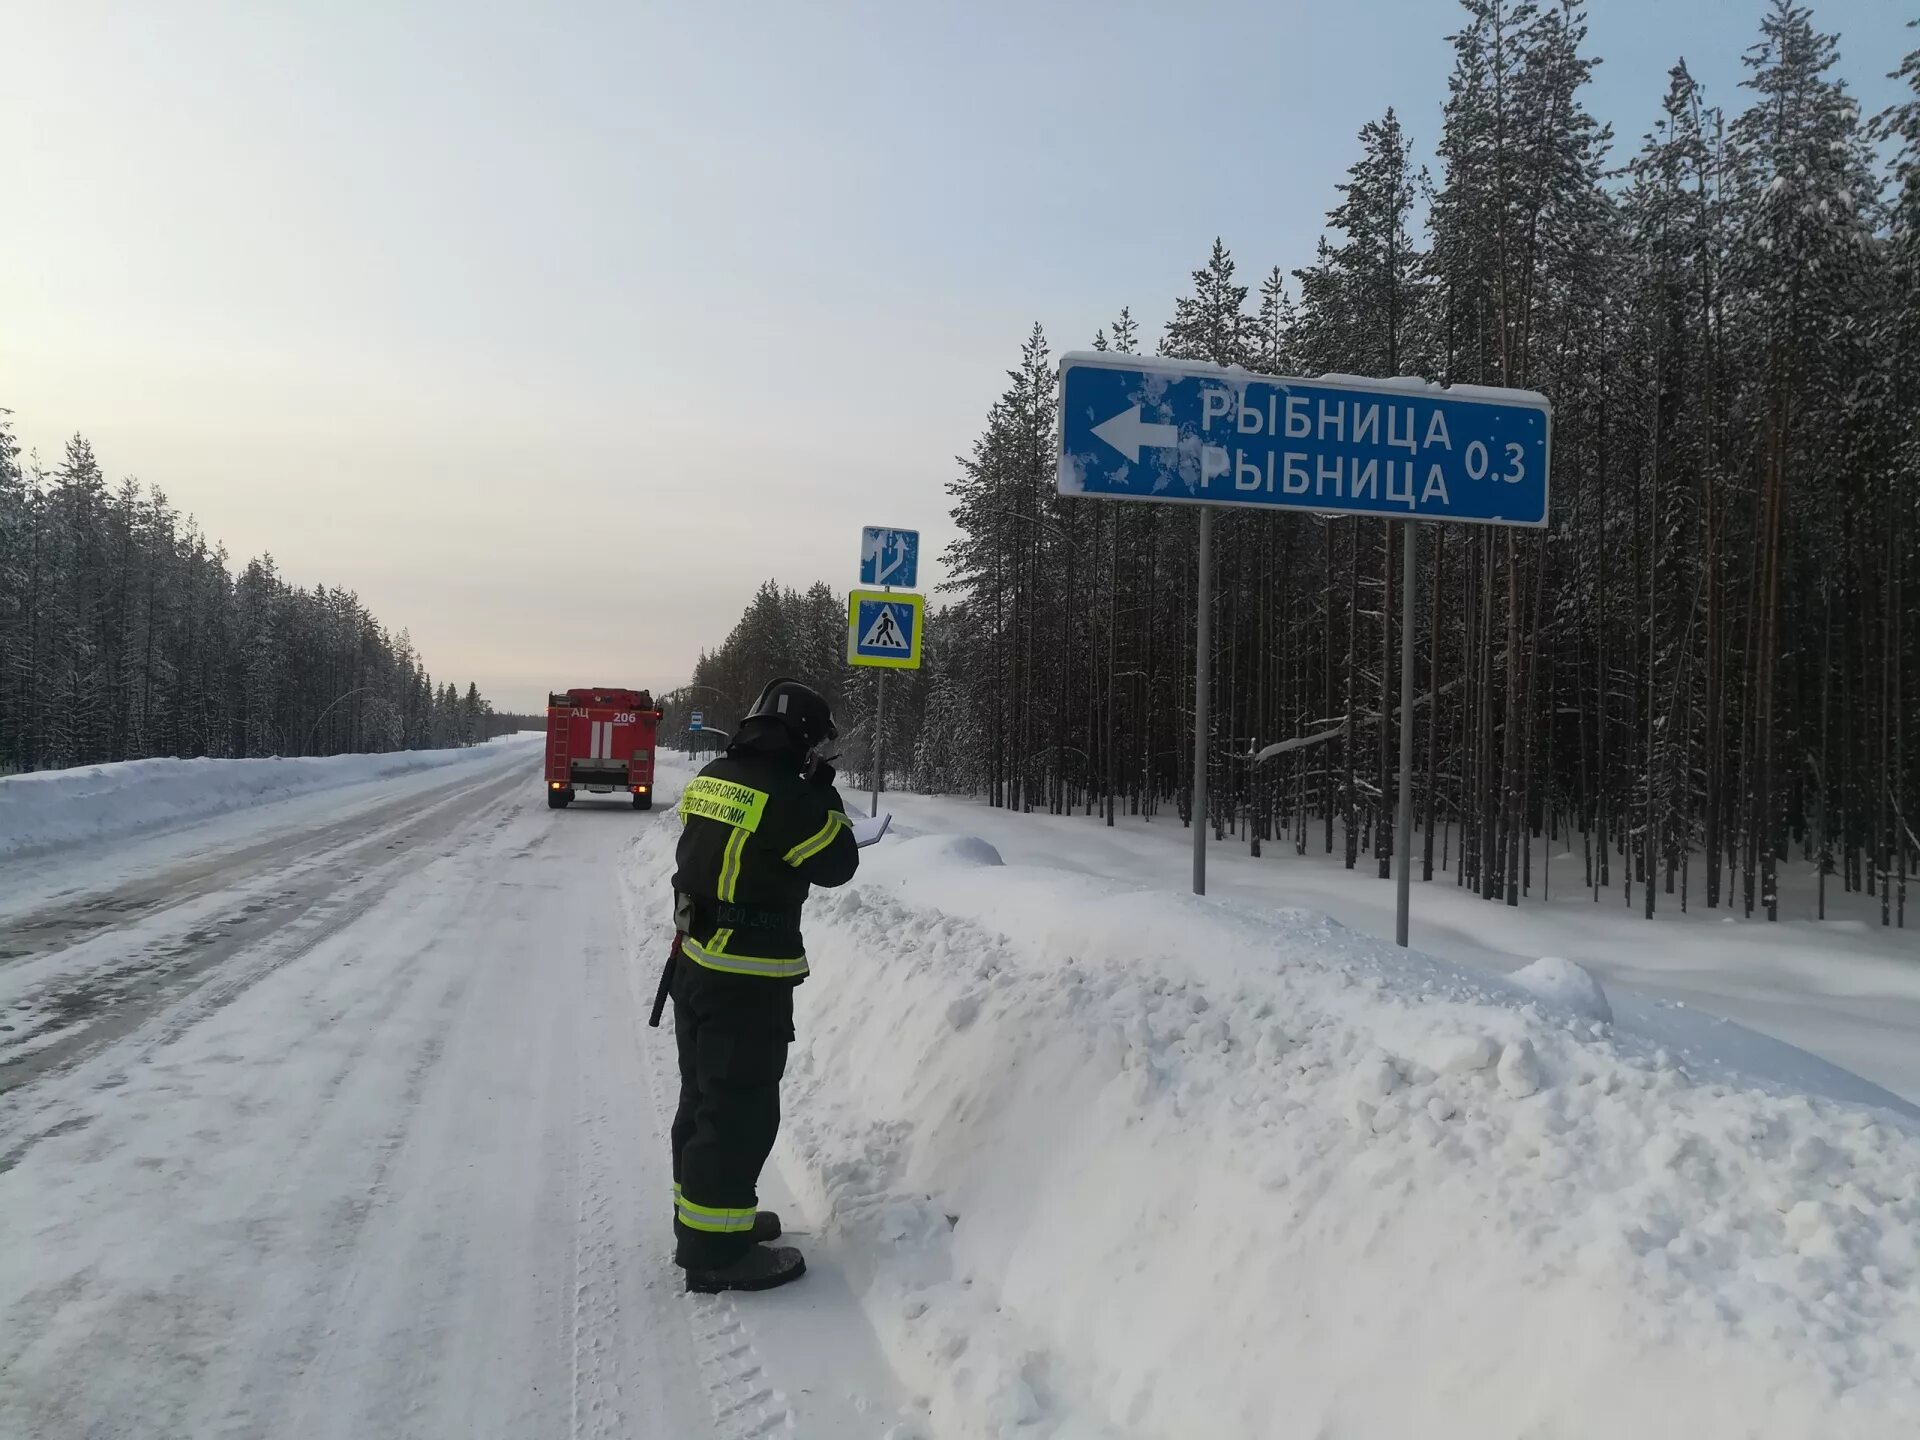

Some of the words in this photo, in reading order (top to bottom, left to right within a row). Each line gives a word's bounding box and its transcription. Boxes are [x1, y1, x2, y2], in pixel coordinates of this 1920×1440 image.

[1202, 388, 1453, 456] РЫБНИЦА
[1464, 440, 1526, 484] 0.3
[1200, 445, 1451, 511] РЫБНИЦА
[571, 708, 589, 719] АЦ
[613, 712, 636, 723] 206
[720, 784, 756, 807] ОХРАНА
[718, 804, 746, 824] КОМИ
